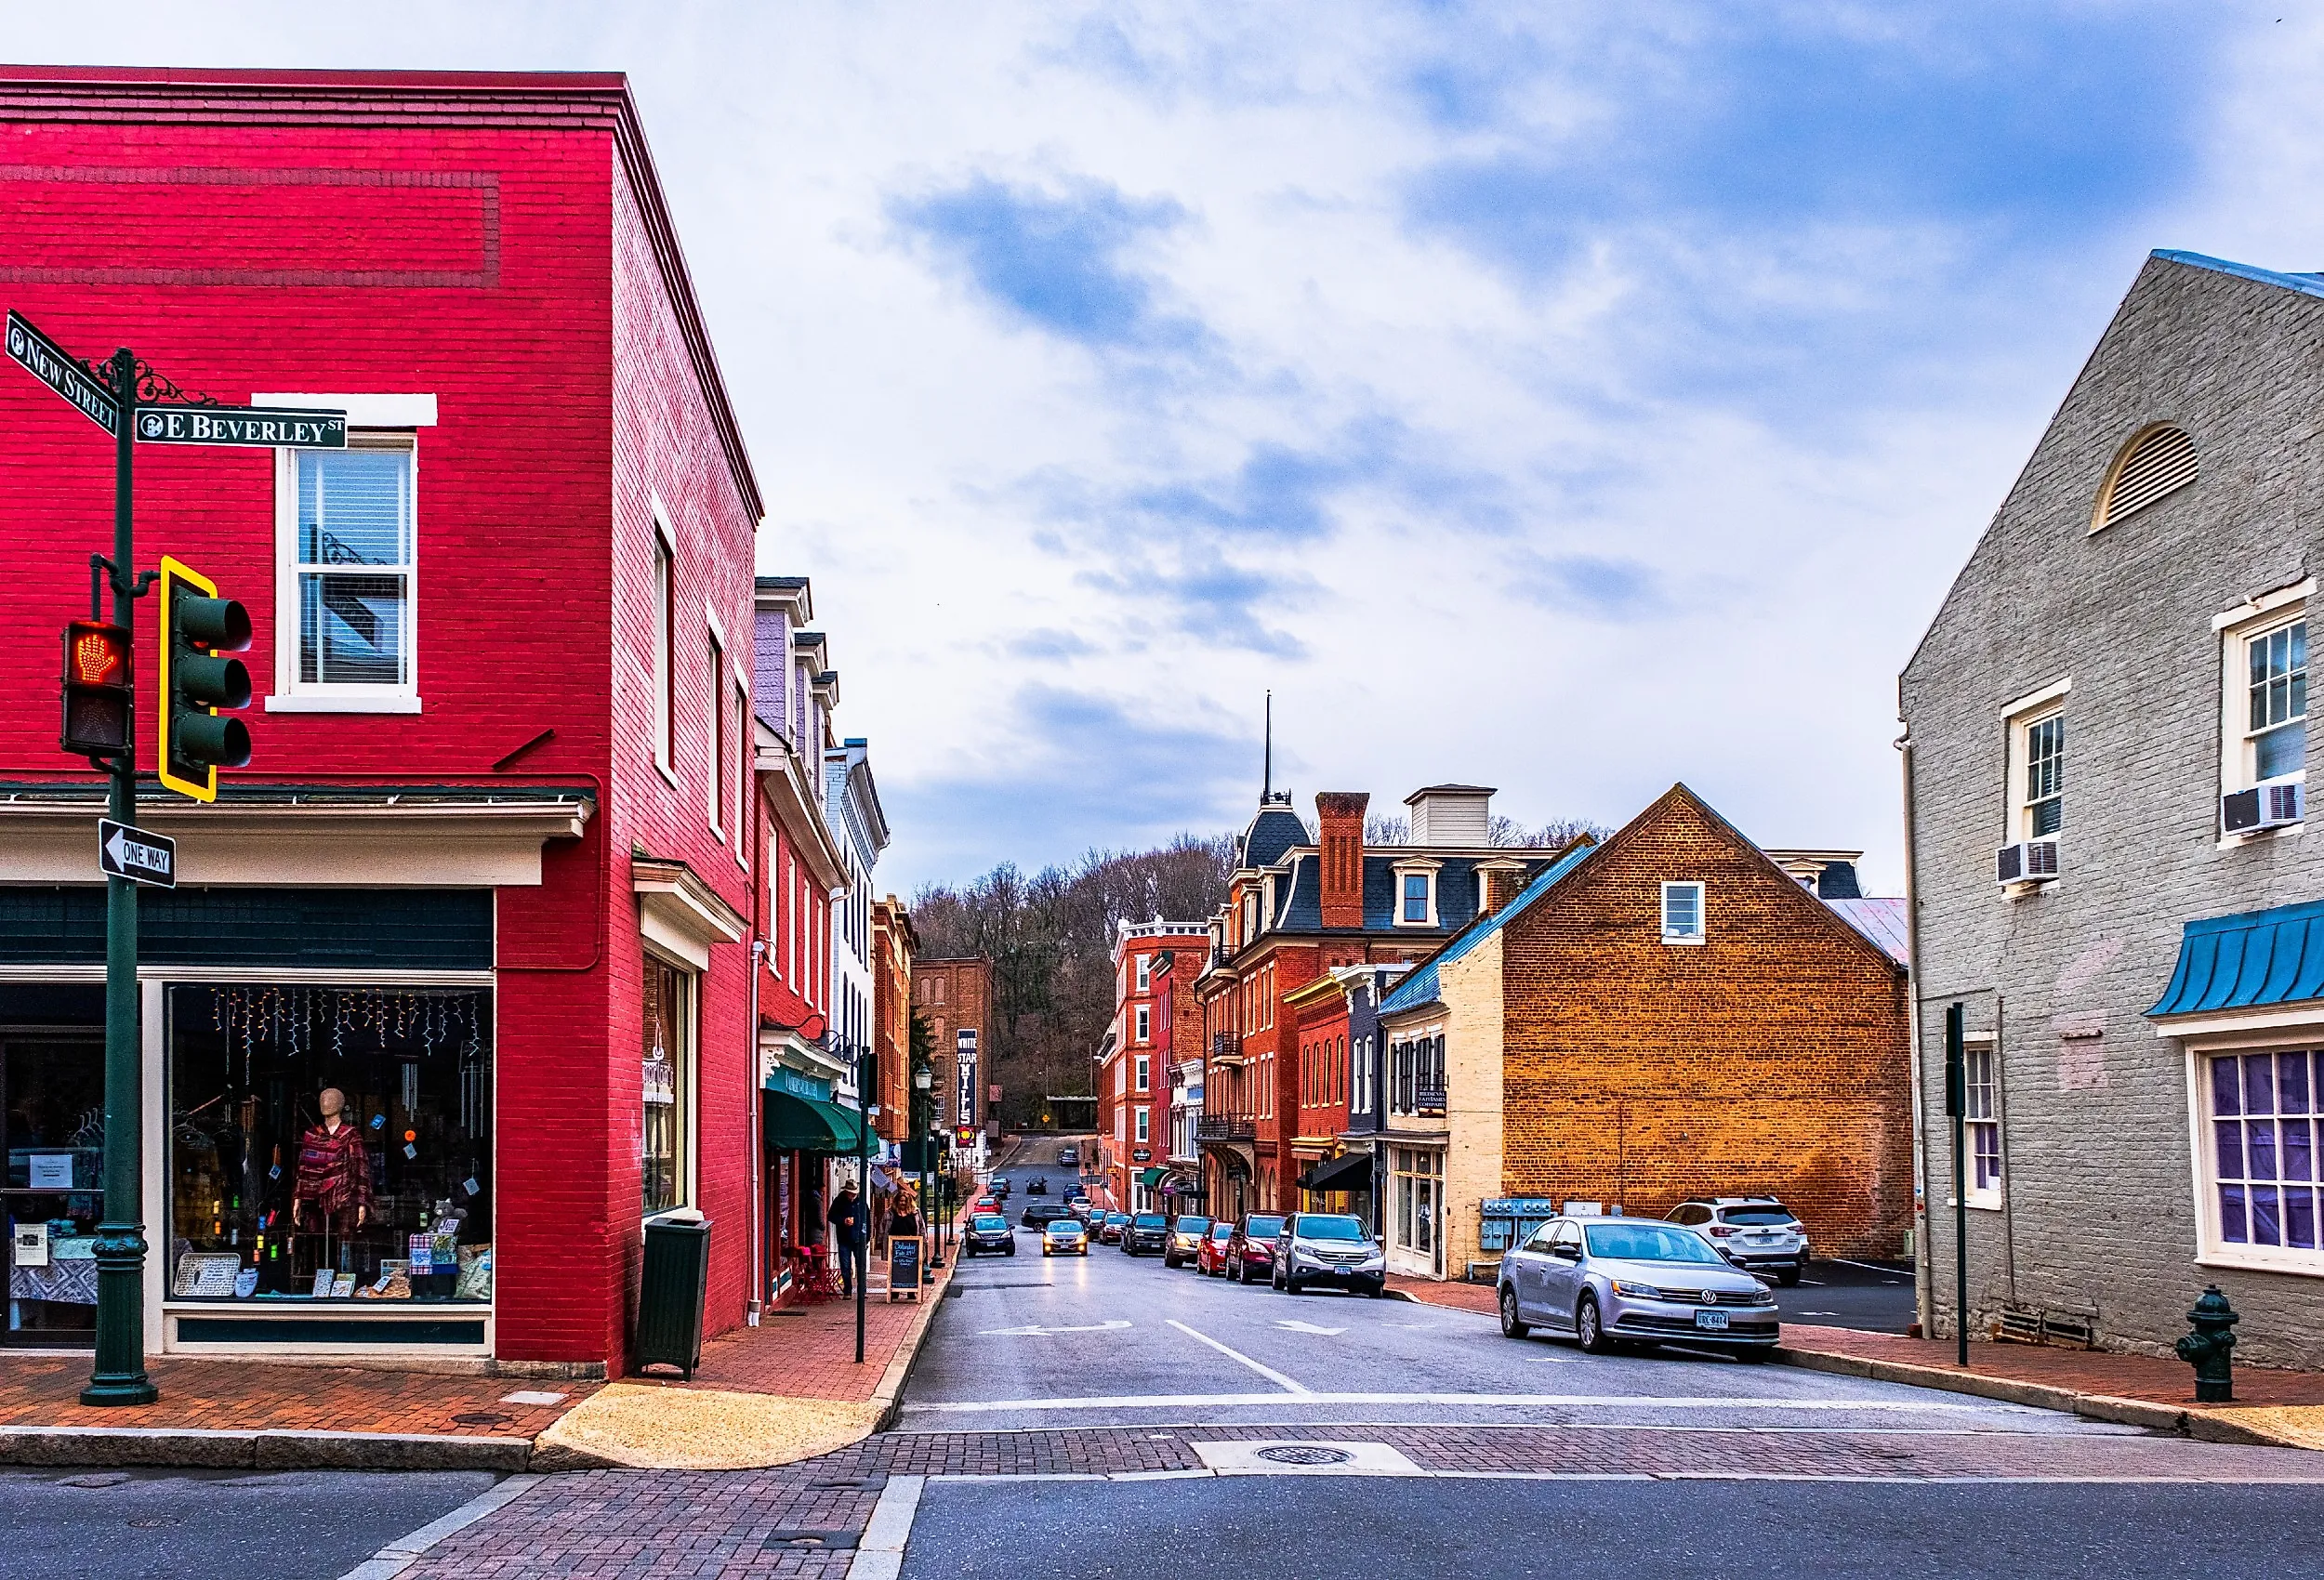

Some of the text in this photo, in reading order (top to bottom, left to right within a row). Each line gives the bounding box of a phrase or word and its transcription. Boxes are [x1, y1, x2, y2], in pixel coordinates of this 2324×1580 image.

[25, 336, 116, 429] NEW STREET
[165, 414, 345, 442] E BEVERLEY ST
[123, 842, 168, 871] ONE WAY
[957, 1037, 977, 1049] WHITE
[957, 1052, 977, 1064] STAR
[959, 1064, 971, 1125] MILLS
